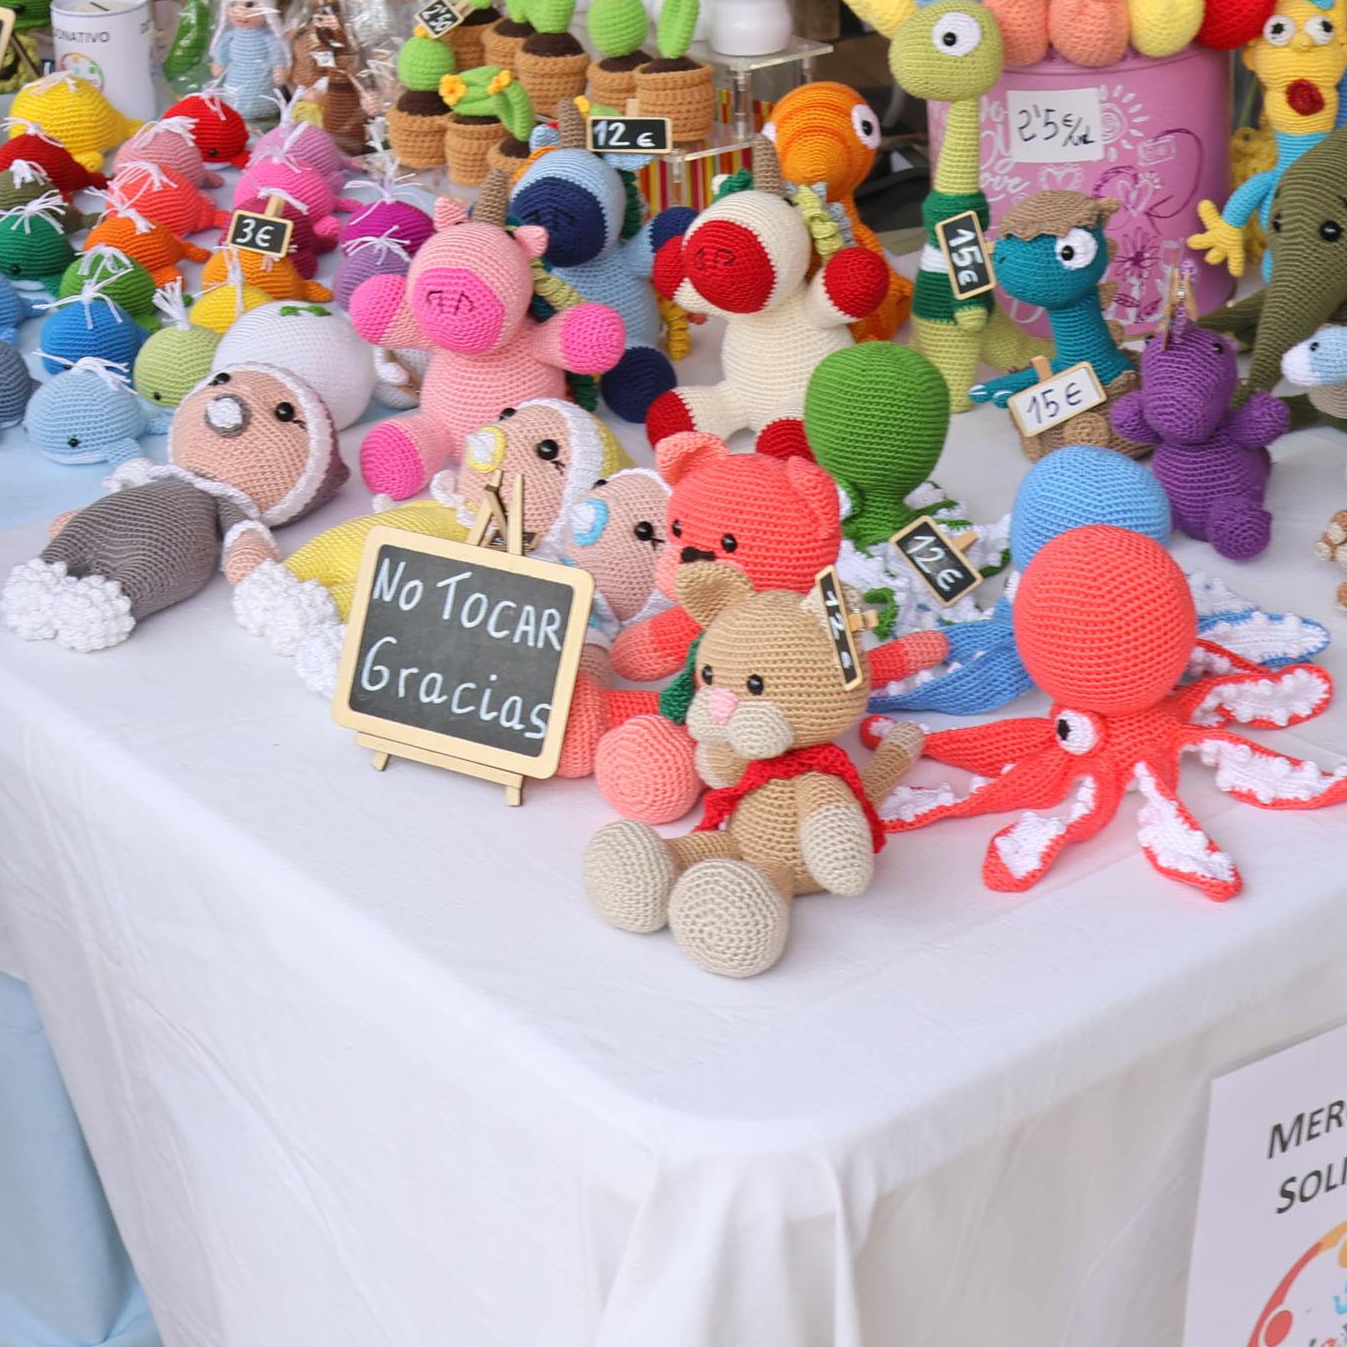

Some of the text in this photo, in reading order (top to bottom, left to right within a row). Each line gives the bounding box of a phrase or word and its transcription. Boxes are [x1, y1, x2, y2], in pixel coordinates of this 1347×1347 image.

[235, 218, 275, 248] 3€
[948, 228, 984, 286] 15€
[1026, 382, 1083, 424] 15€
[906, 535, 964, 592] 12€
[436, 571, 562, 652] TOCAR
[360, 636, 552, 740] Gracias
